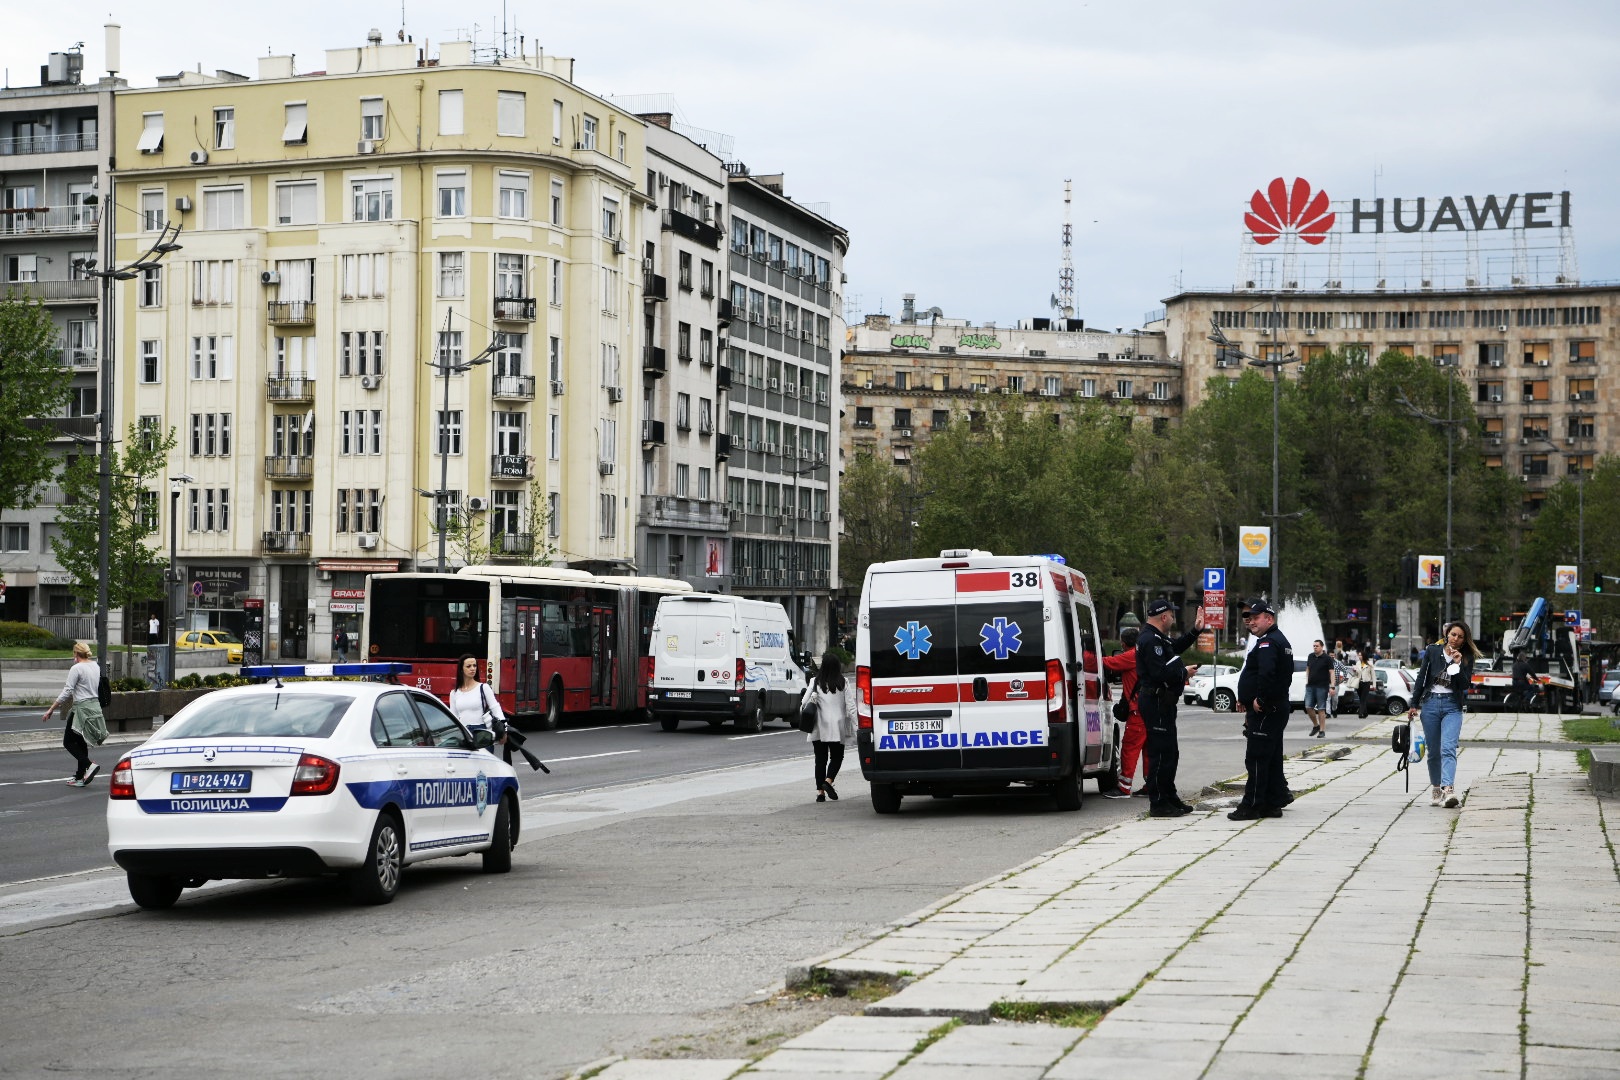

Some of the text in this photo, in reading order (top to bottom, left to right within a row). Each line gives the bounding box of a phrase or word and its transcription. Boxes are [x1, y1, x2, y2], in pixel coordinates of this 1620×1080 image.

[1352, 191, 1571, 233] HUAWEI
[195, 570, 242, 578] PUTNIK
[1011, 572, 1038, 588] 38
[1208, 571, 1220, 588] P
[417, 677, 430, 685] 971
[894, 721, 904, 730] BG
[878, 730, 1044, 750] AMBULANCE
[416, 781, 474, 806] ПОЛИЦИЈА
[171, 799, 250, 812] ПОЛИЦИЈА
